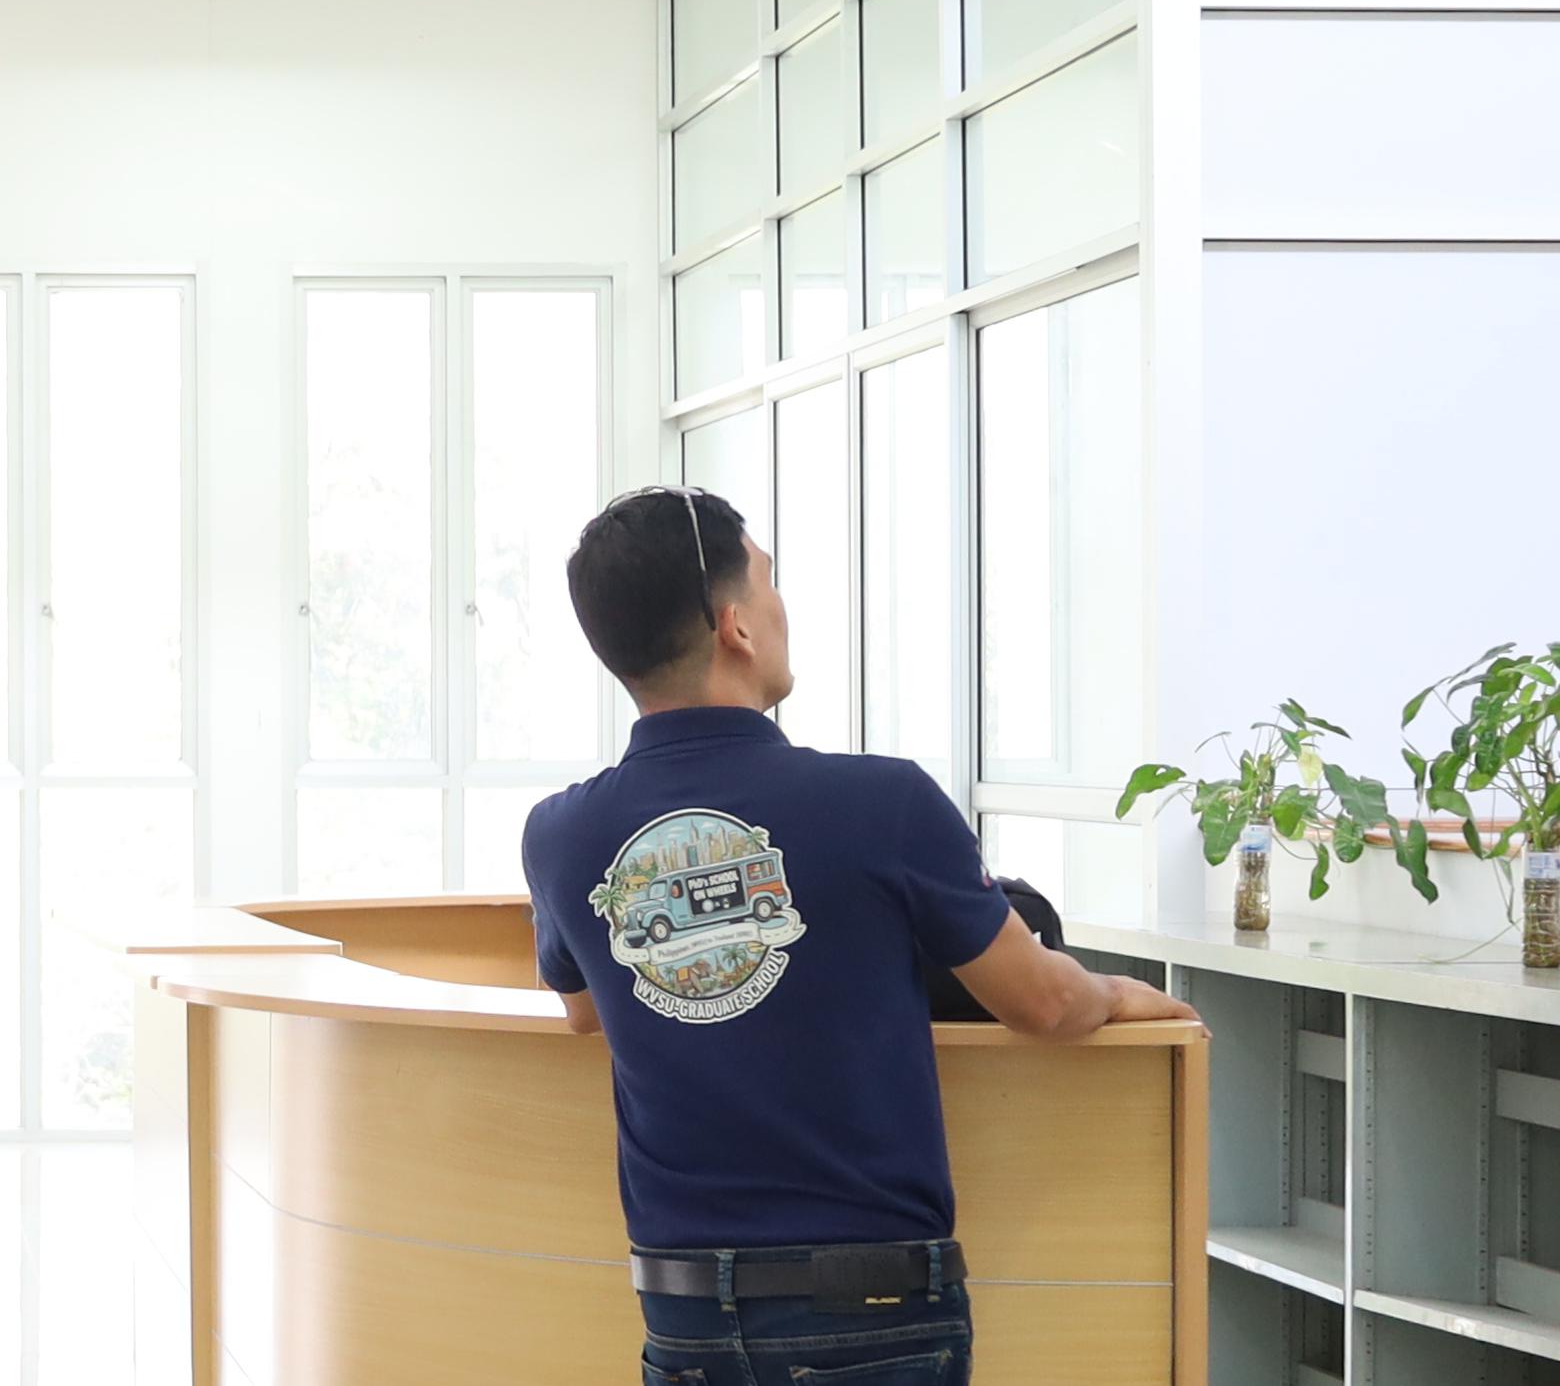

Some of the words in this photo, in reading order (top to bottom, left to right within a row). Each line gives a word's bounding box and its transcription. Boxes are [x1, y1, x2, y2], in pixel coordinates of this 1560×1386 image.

[709, 870, 739, 885] SCHOOL
[693, 890, 706, 901] ON
[706, 883, 737, 897] WHEELS
[743, 949, 785, 1004] SCHOOL
